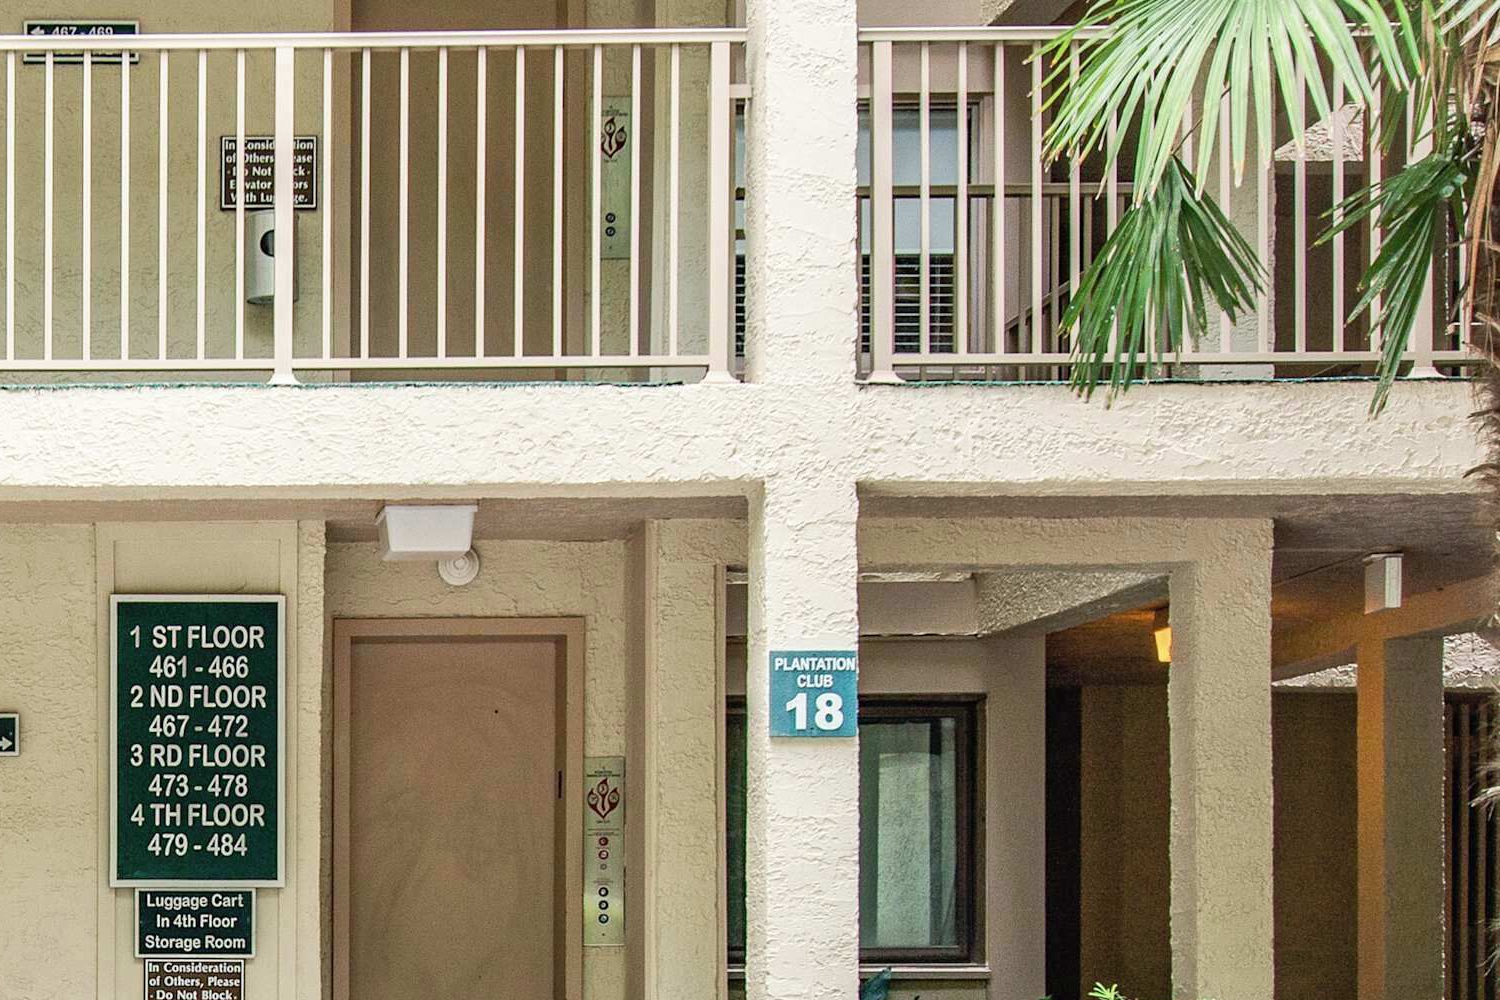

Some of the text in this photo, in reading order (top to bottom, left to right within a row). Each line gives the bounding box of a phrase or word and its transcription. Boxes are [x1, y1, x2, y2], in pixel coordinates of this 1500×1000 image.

[225, 141, 236, 150] In
[252, 166, 272, 176] Not
[229, 179, 272, 189] Evator
[130, 625, 265, 648] 1 ST FLOOR
[149, 655, 188, 679] 461
[207, 655, 249, 679] 466
[774, 657, 856, 671] PLANTATION
[797, 674, 834, 688] CLUB
[130, 685, 267, 708] 2 ND FLOOR
[786, 692, 844, 731] 18
[148, 714, 189, 738] 467
[207, 714, 248, 738] 472
[130, 744, 266, 767] 3 RD FLOOR
[148, 774, 189, 797] 473
[207, 774, 248, 797] 478
[130, 804, 265, 826] 4 TH FLOOR
[147, 833, 188, 857] 479
[206, 833, 248, 857] 484
[146, 893, 244, 911] Luggage Cart
[156, 914, 238, 928] In 4th Floor
[144, 935, 246, 952] Storage Room
[148, 962, 241, 973] In Consideration
[149, 976, 241, 988] of Others, Please
[155, 990, 174, 1000] Do
[176, 990, 198, 1000] Not
